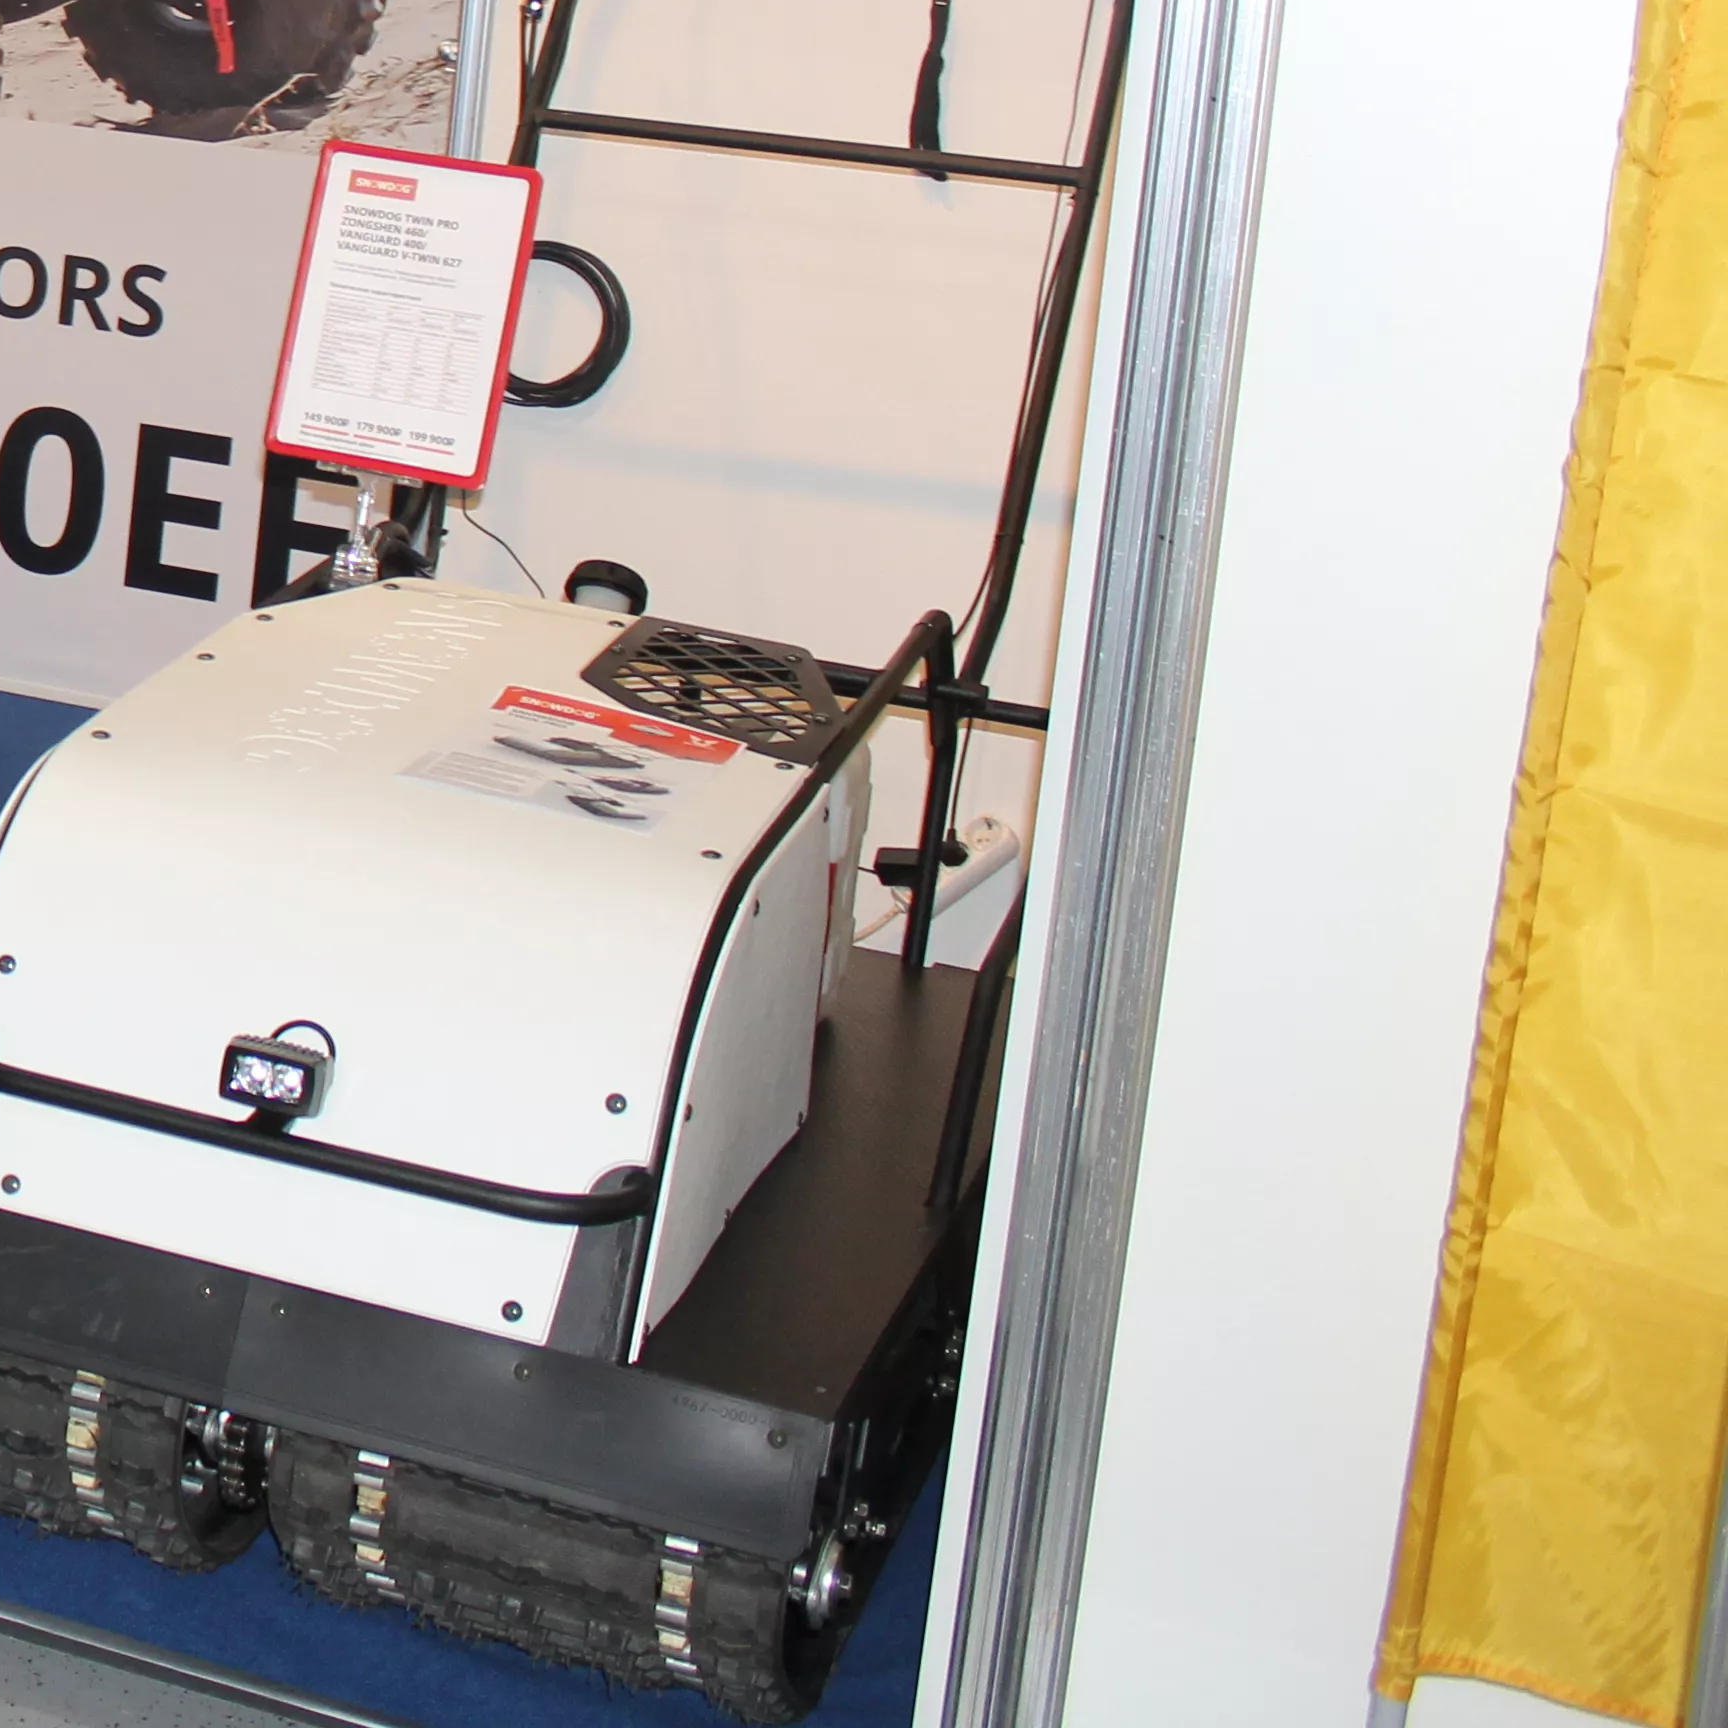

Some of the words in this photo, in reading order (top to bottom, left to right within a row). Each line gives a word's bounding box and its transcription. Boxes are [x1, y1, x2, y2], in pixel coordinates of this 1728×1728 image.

[436, 218, 460, 231] PRO
[339, 228, 402, 246] VANGUARD
[336, 240, 399, 258] VANGUARD
[518, 695, 602, 720] SNOWDOG
